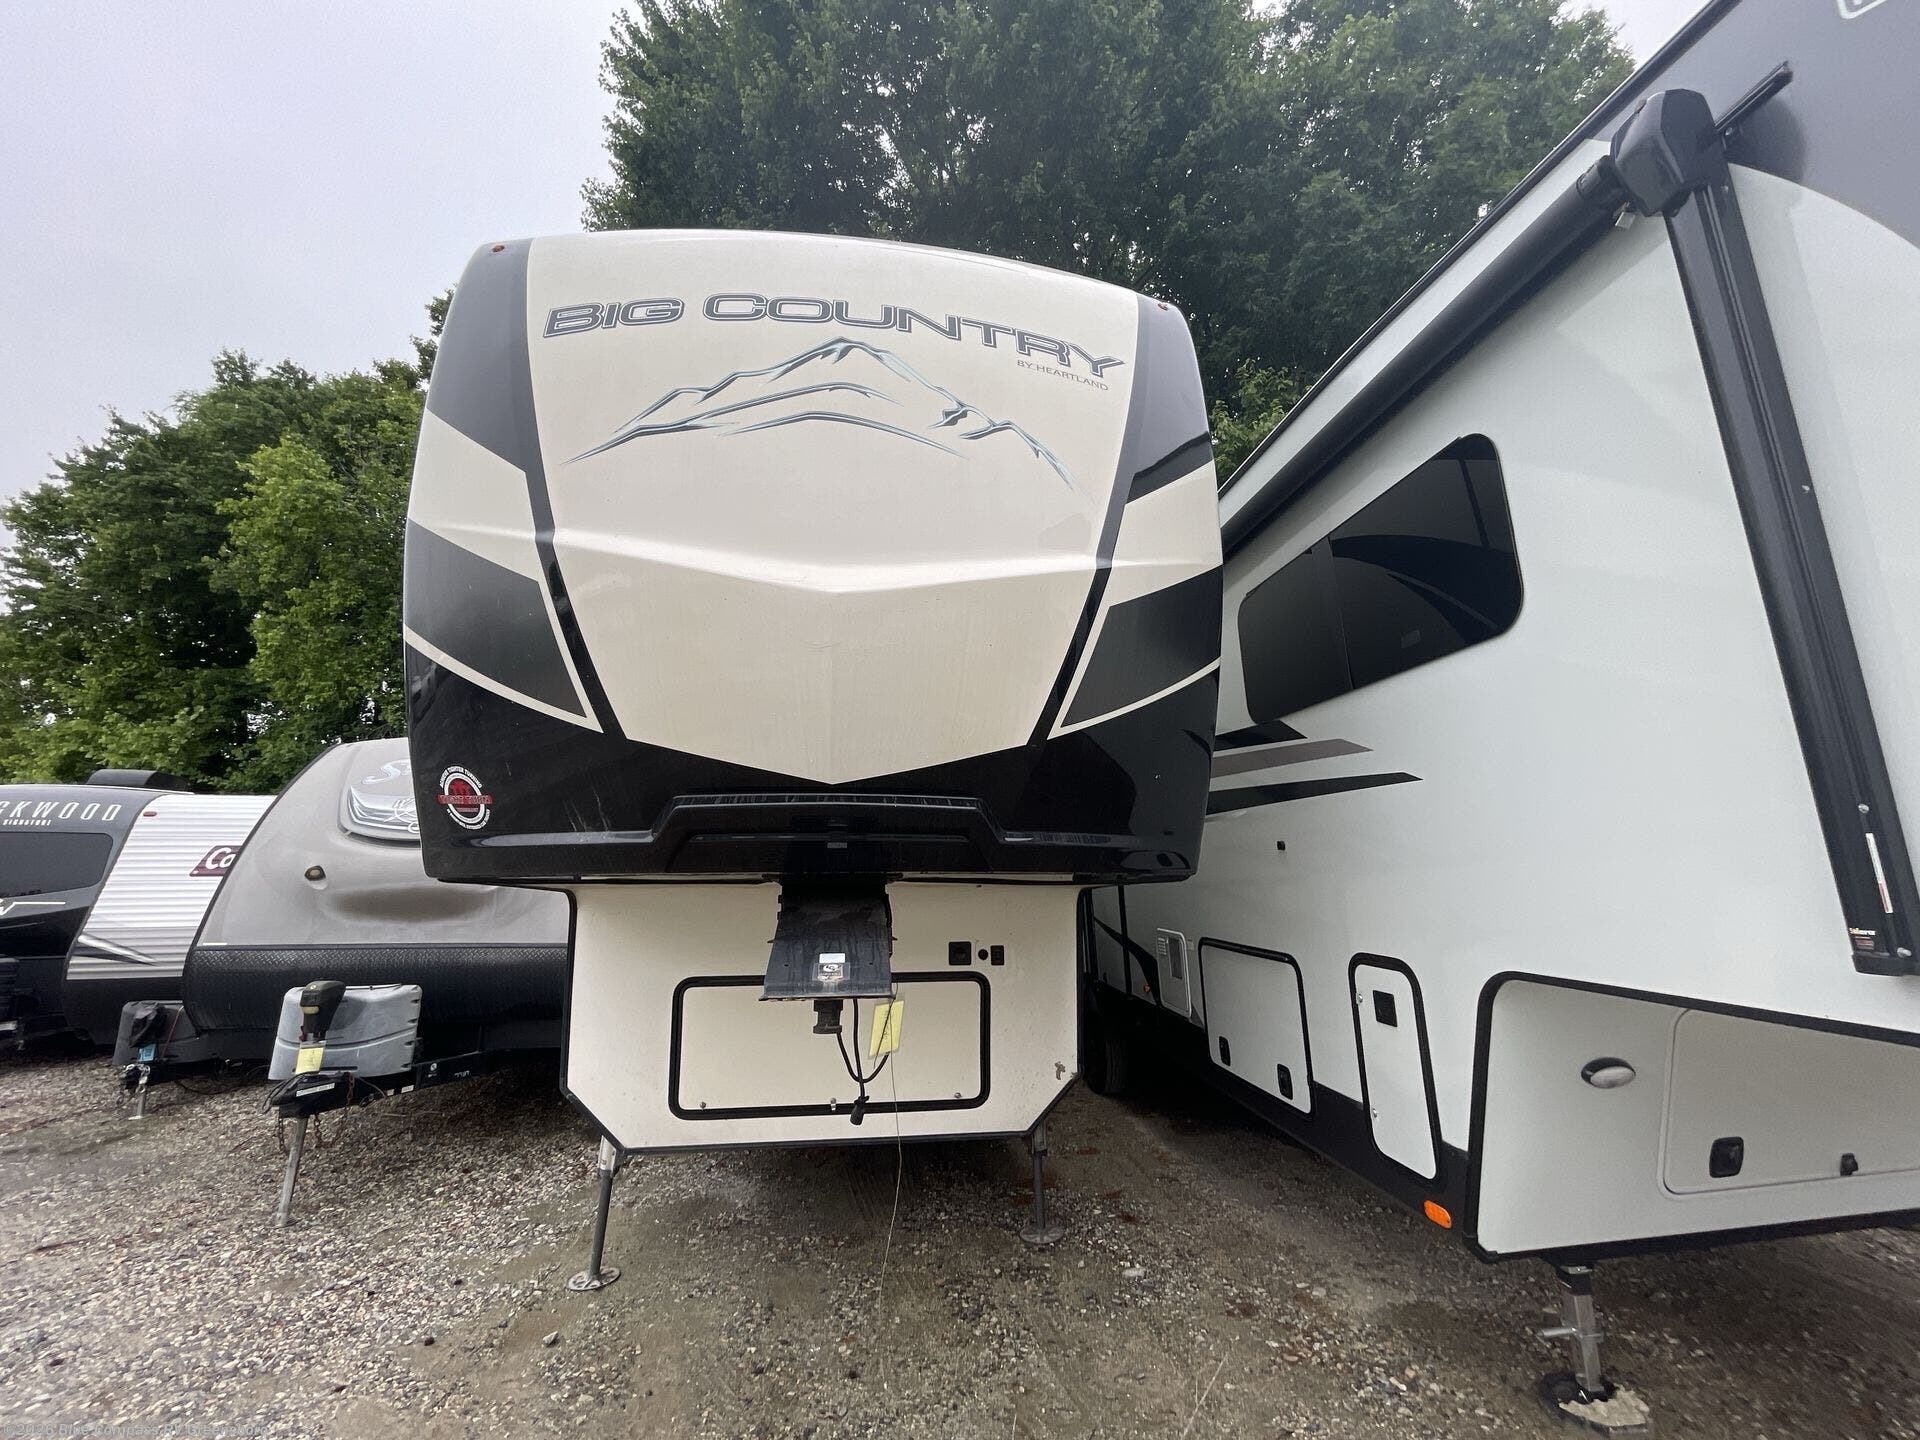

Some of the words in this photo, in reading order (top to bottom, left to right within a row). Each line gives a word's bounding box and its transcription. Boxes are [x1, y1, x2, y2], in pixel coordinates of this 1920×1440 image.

[543, 297, 684, 339] BIG
[703, 291, 1125, 380] COUNTRY
[1017, 359, 1032, 369] BY
[1036, 364, 1109, 391] HEARTLAND
